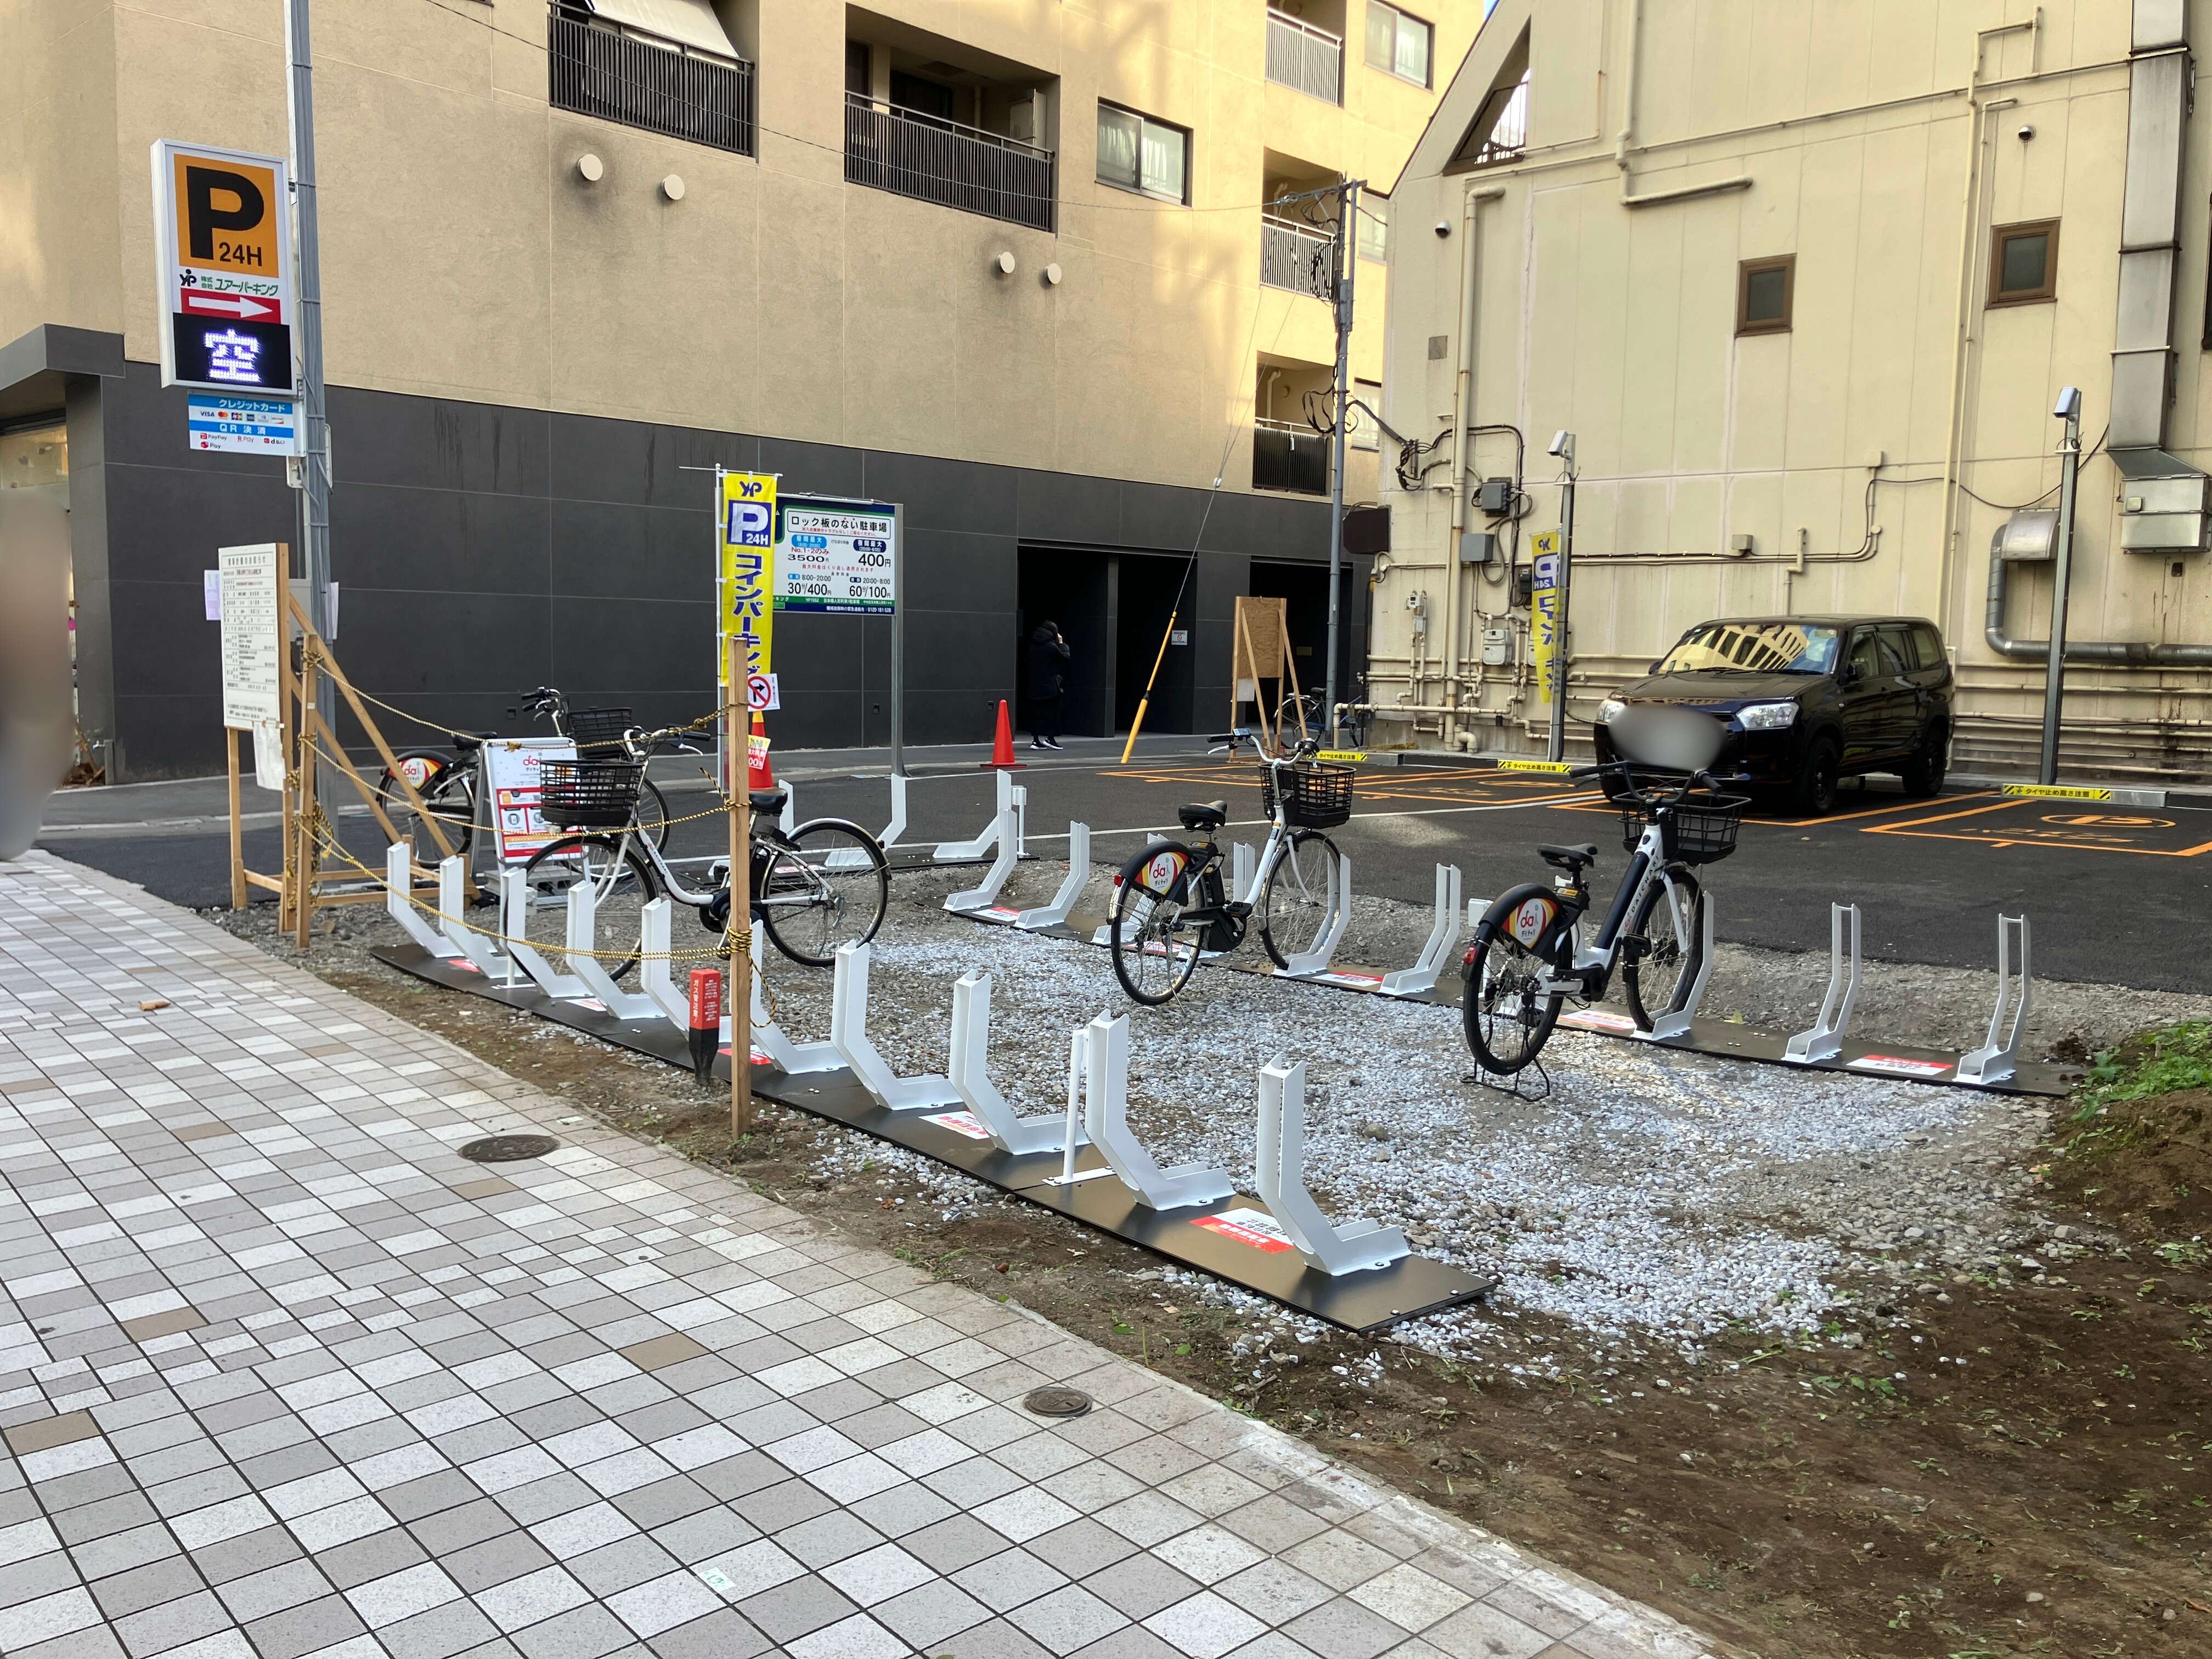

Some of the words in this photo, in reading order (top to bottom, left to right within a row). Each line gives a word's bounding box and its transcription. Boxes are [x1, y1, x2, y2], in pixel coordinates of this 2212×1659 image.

[186, 166, 264, 260] P
[219, 242, 262, 267] 24H
[215, 278, 278, 296] ユアーパーキング
[205, 329, 261, 382] 空
[219, 399, 285, 413] クレジットカード
[731, 503, 768, 543] P
[792, 516, 887, 532] ロック板のない駐車場
[746, 533, 768, 545] 24H
[858, 553, 891, 568] 400円
[2025, 788, 2090, 798] タイヤ止め高さ注意
